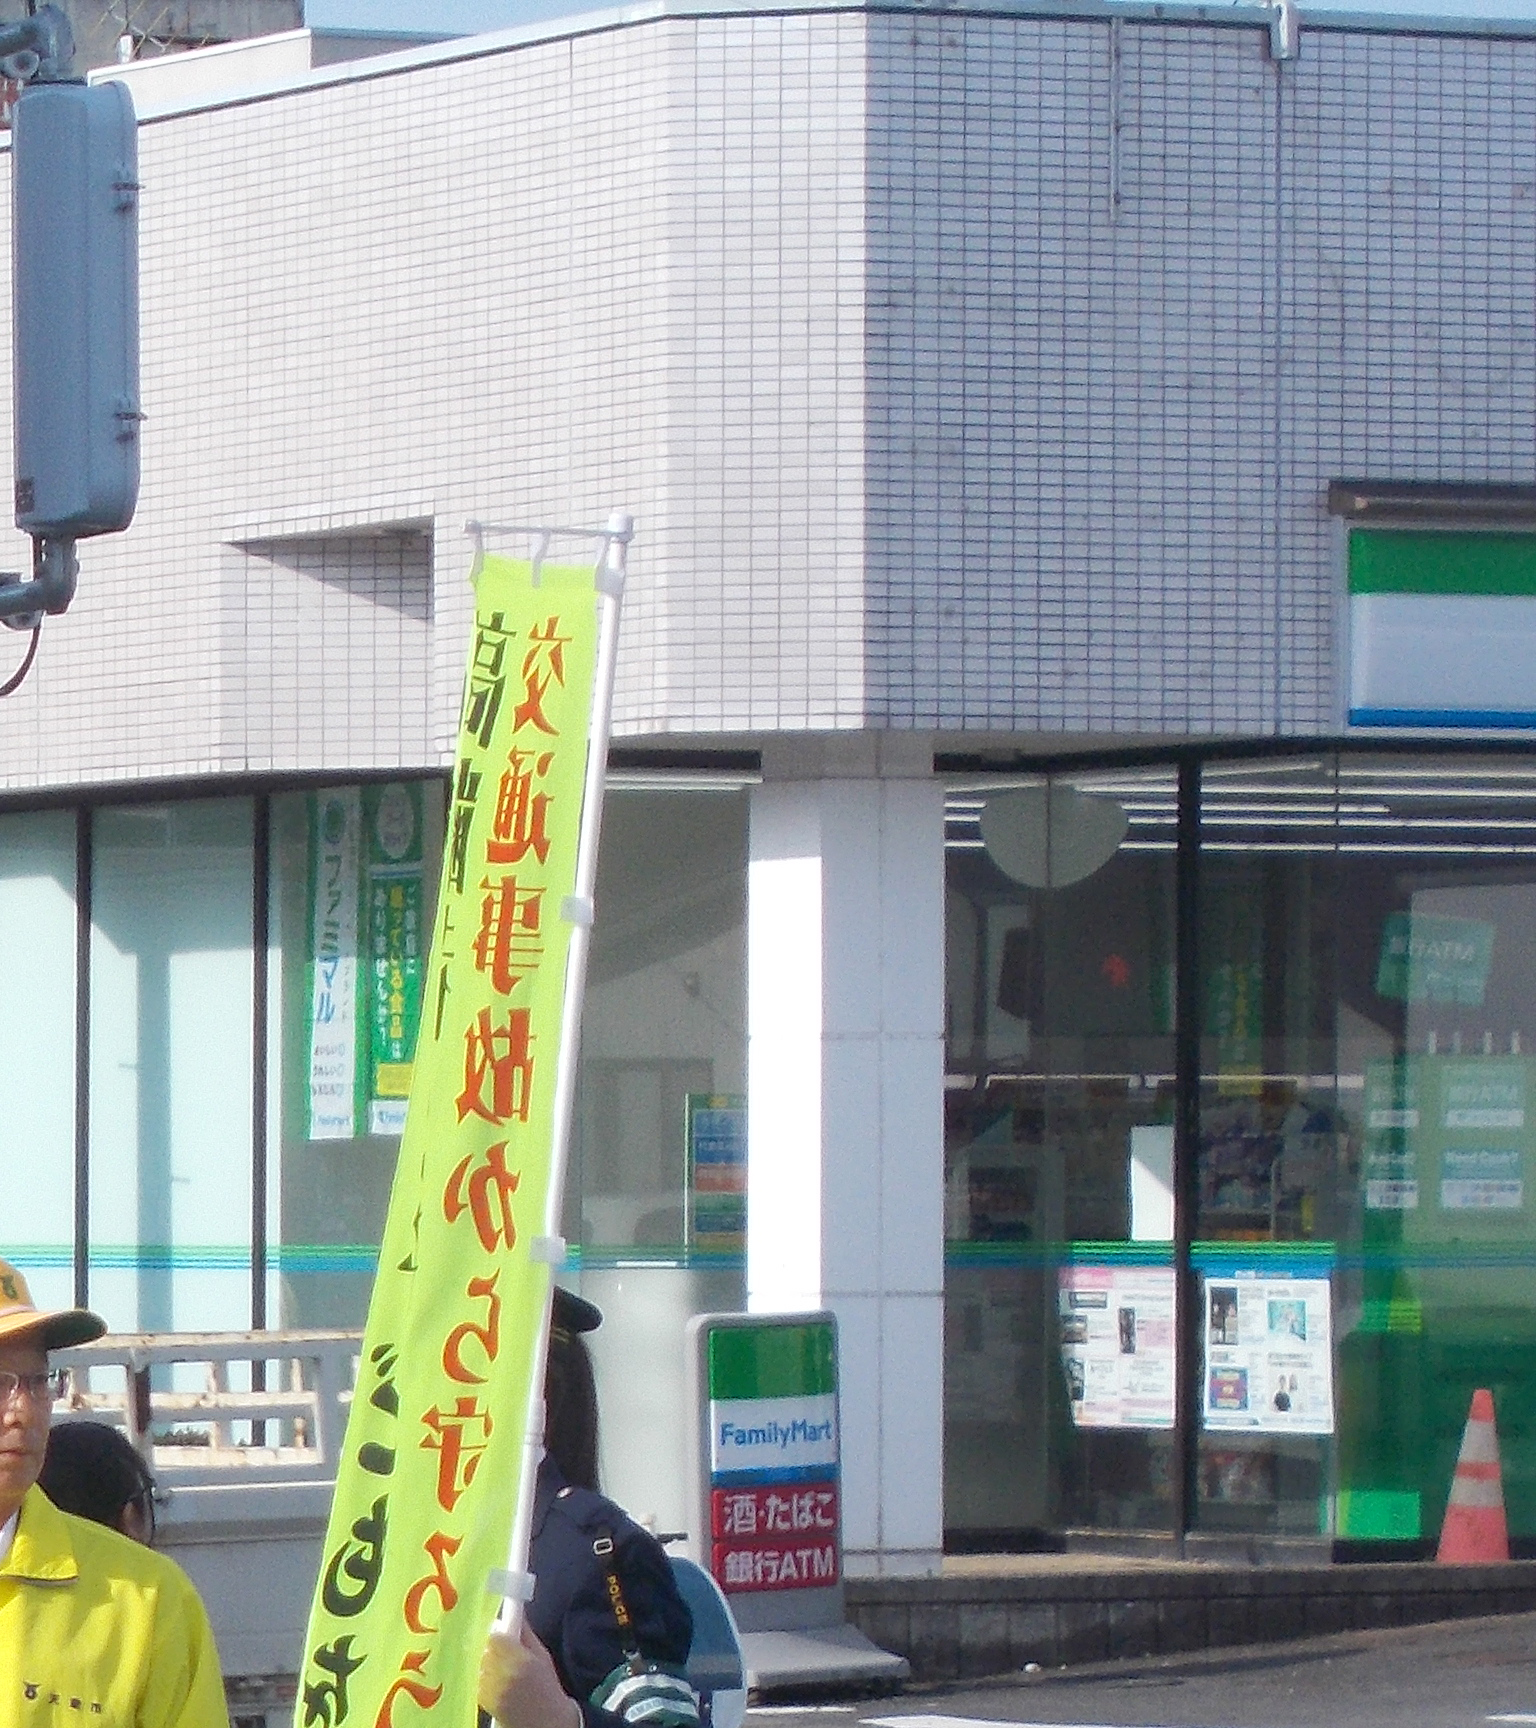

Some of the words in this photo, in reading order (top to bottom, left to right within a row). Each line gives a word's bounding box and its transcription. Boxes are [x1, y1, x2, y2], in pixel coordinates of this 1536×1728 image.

[720, 1418, 833, 1449] FamilyMart
[723, 1491, 835, 1534] 酒・たばこ
[724, 1546, 834, 1583] 銀行ATM
[606, 1573, 631, 1627] POLICE
